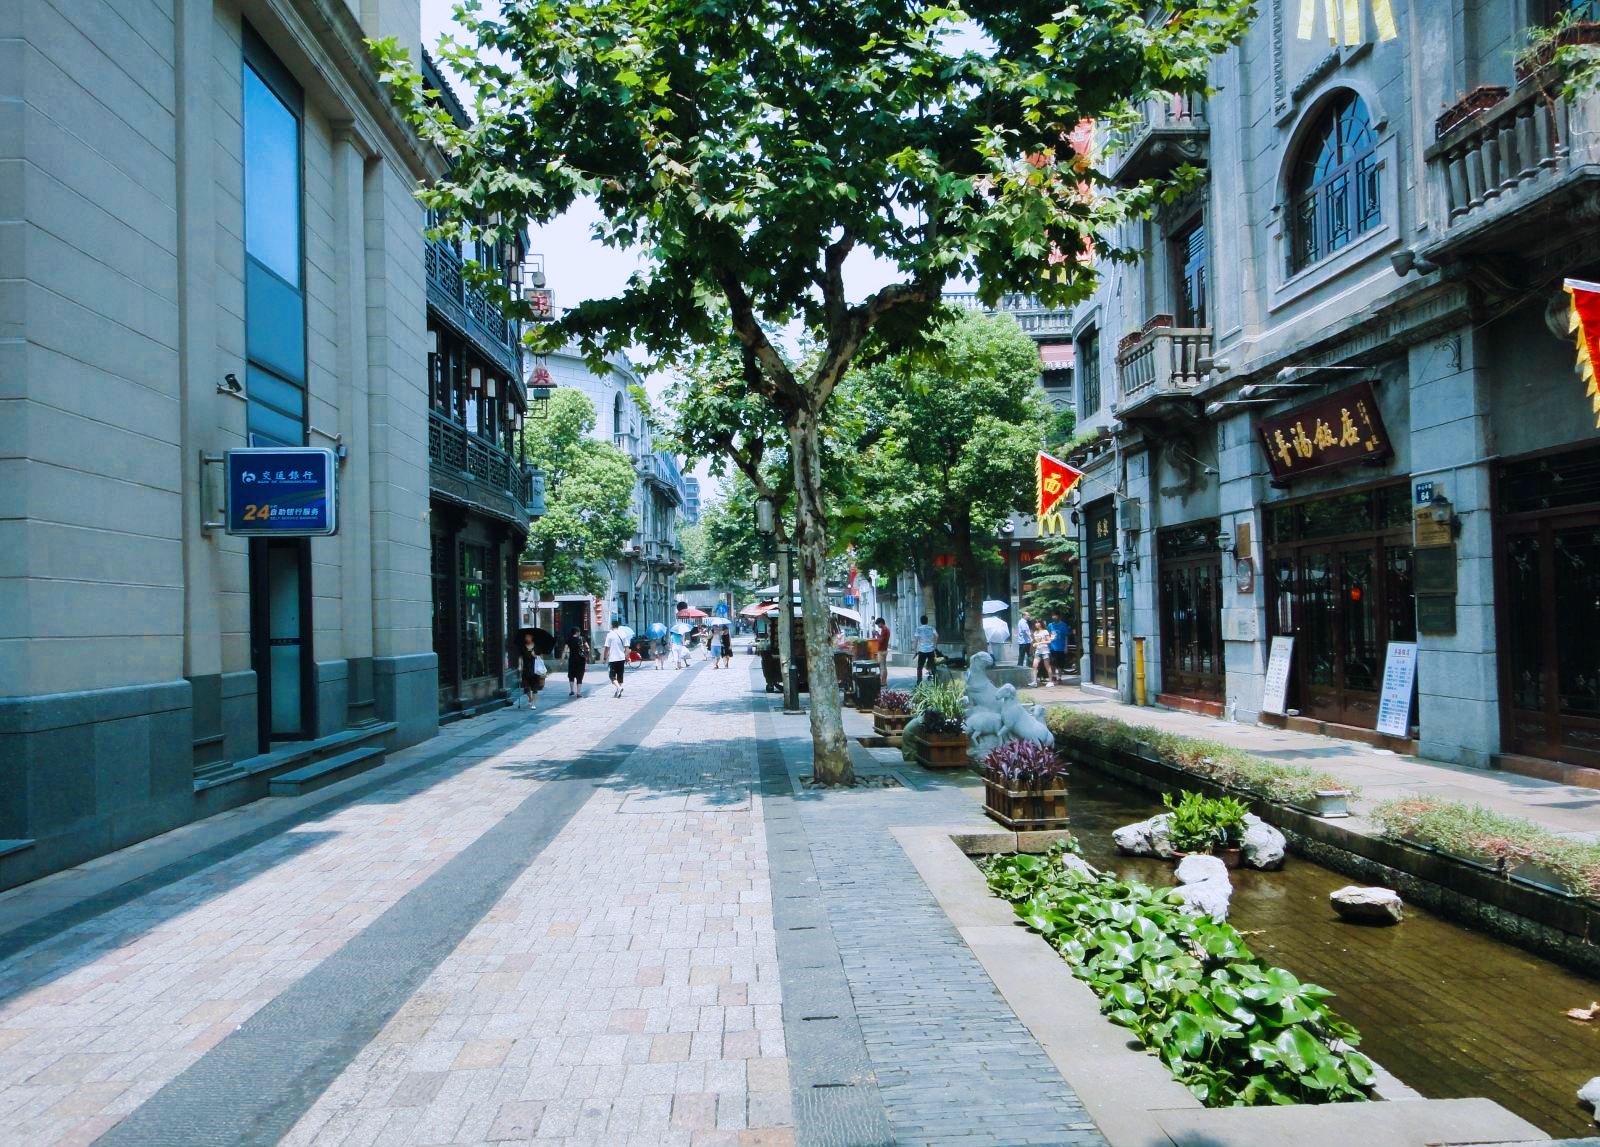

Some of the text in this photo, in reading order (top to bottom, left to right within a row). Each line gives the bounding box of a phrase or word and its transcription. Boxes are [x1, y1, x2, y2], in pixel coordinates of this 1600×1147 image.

[1044, 472, 1062, 494] 面
[1420, 491, 1430, 501] 64
[243, 504, 270, 520] 24
